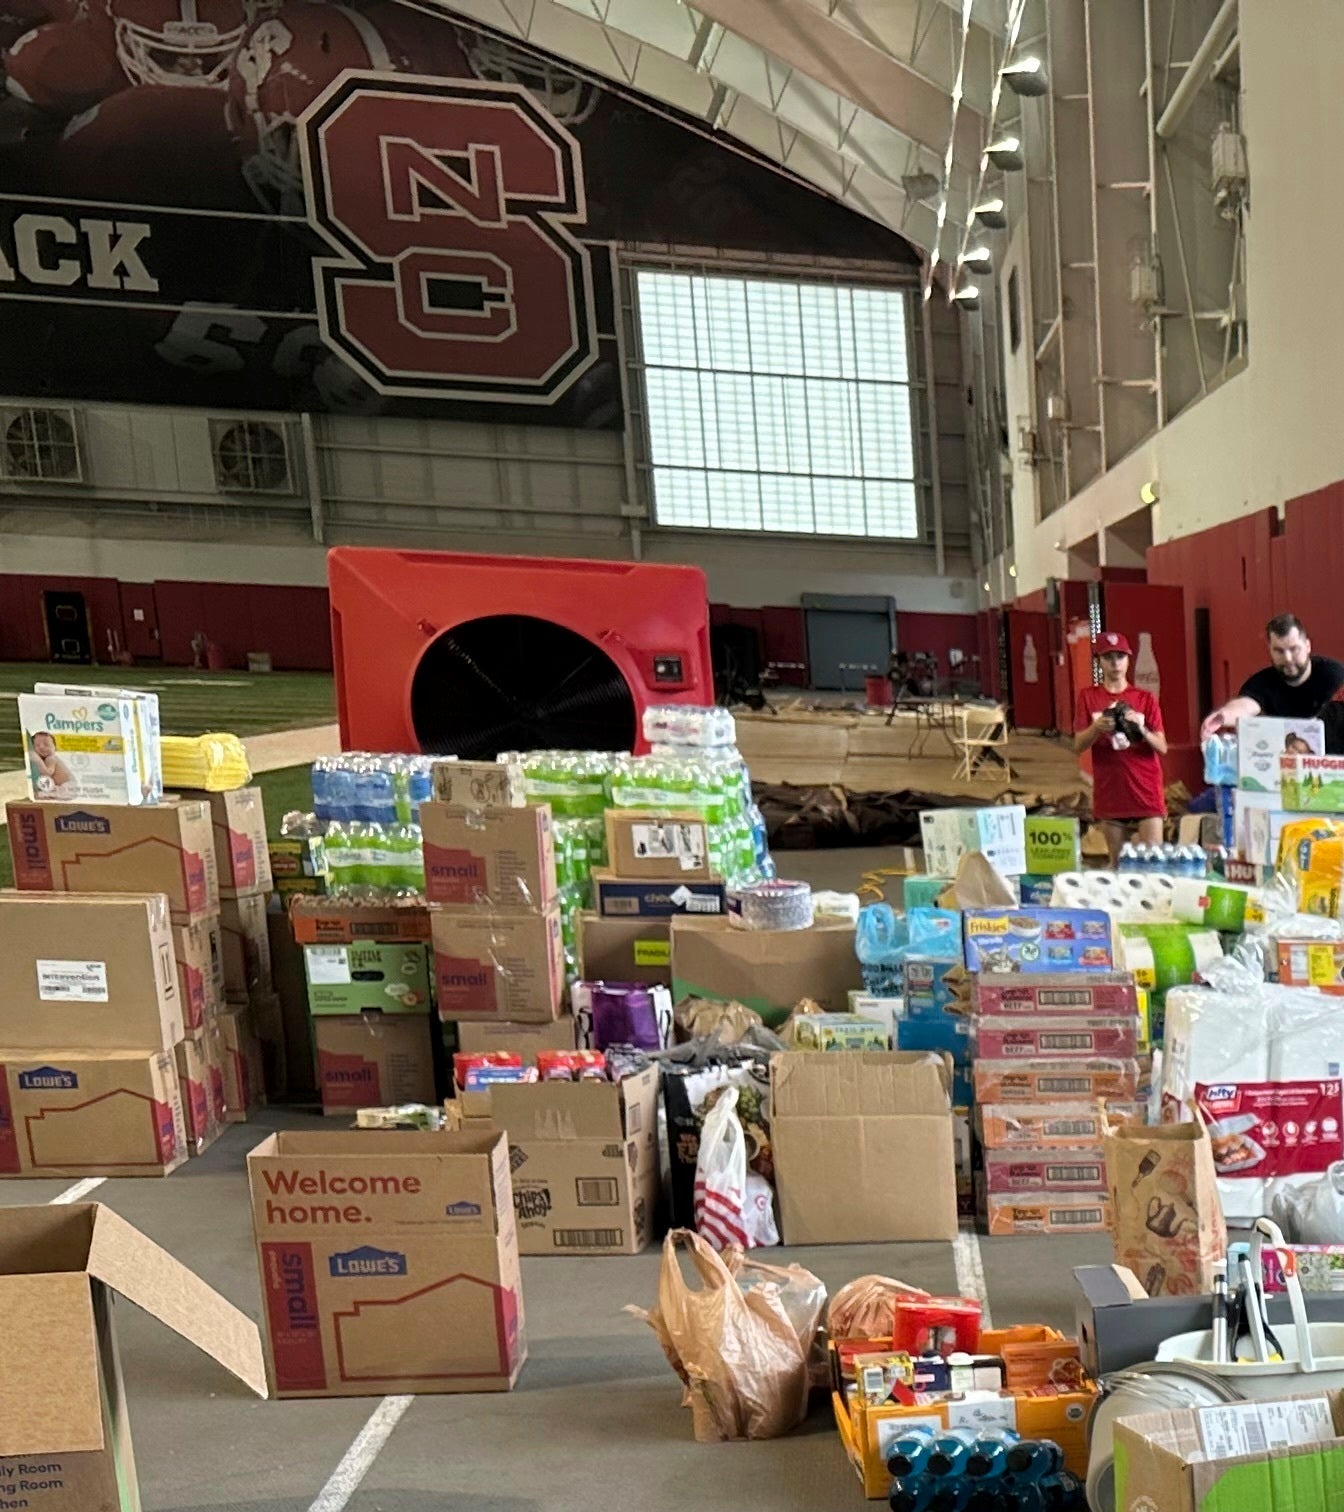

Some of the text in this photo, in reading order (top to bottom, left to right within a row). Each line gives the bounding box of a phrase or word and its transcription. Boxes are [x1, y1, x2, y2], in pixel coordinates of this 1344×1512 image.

[45, 713, 104, 733] Pampers
[59, 820, 106, 833] LOWE'S
[431, 865, 478, 878] small
[970, 921, 1008, 934] Friskies
[442, 973, 487, 986] small
[25, 1074, 73, 1088] LOWE'S
[325, 1070, 371, 1083] small
[261, 1169, 422, 1196] Welcome
[266, 1199, 373, 1226] home.
[337, 1255, 400, 1276] LOWE'S
[284, 1253, 319, 1331] small
[19, 1462, 62, 1475] Room
[20, 1478, 64, 1491] Room
